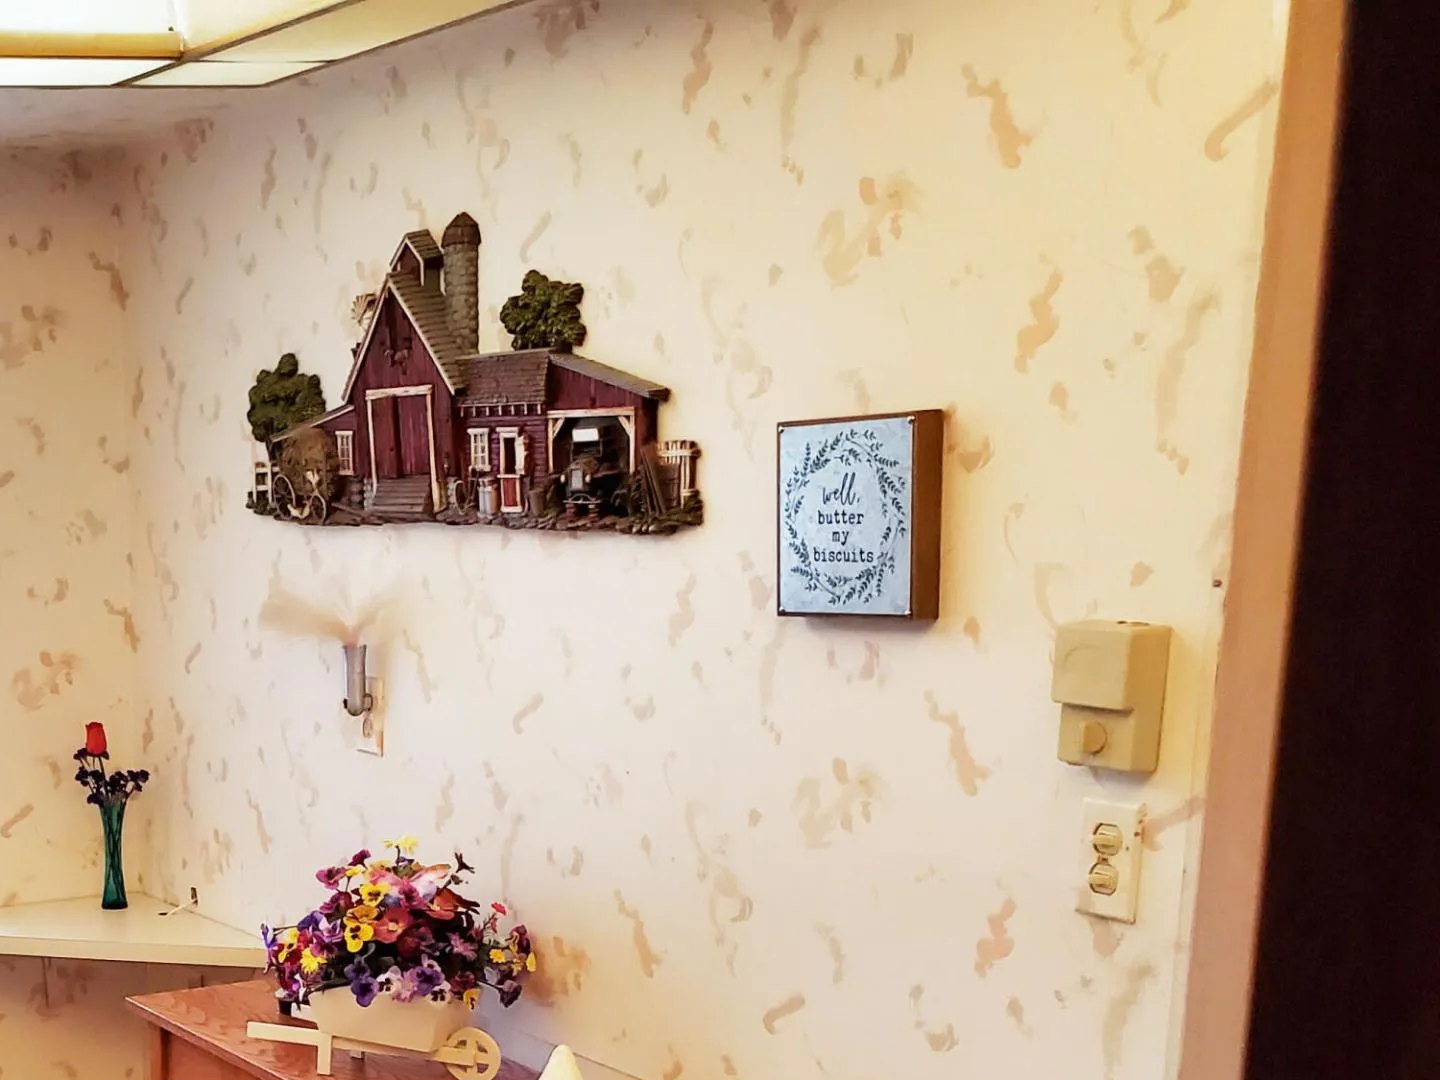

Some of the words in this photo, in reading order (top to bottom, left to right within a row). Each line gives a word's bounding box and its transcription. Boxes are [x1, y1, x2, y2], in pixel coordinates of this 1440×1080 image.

[817, 509, 864, 524] butter
[831, 531, 849, 546] my
[813, 546, 874, 563] biscuits
